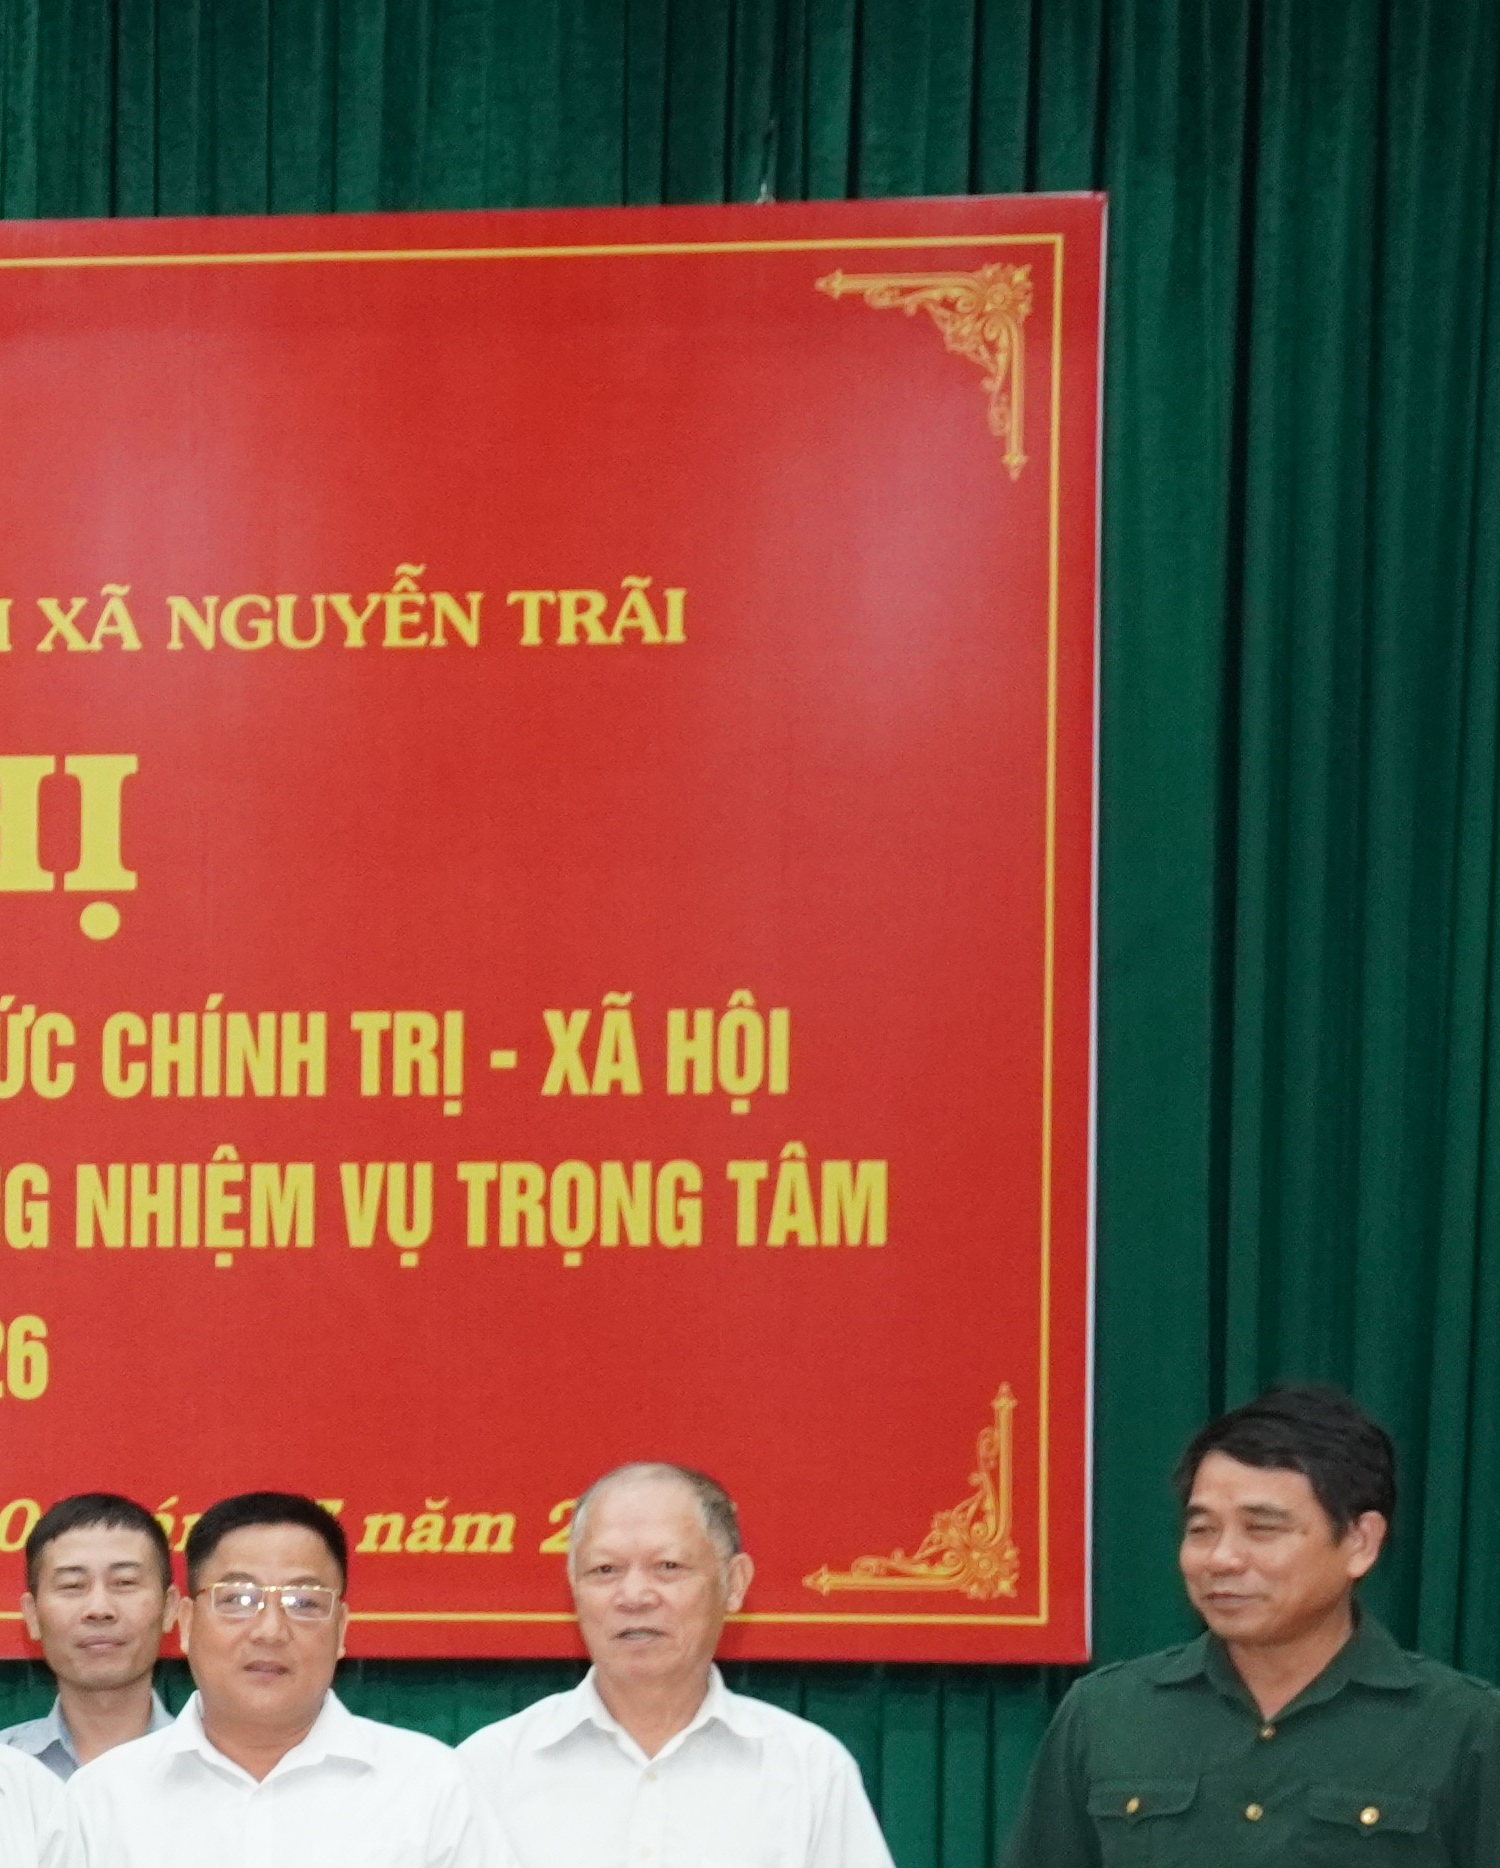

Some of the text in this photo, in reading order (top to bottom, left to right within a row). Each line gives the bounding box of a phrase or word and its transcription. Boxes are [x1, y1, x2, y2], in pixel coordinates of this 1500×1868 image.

[38, 584, 141, 651] XÃ
[167, 563, 481, 650] NGUYỄN
[508, 577, 684, 644] TRÃI
[103, 994, 325, 1098] CHÍNH
[351, 1012, 462, 1114] TRỊ
[491, 1051, 515, 1067] -
[543, 993, 640, 1094] XÃ
[668, 990, 788, 1113] HỘI
[77, 1145, 314, 1267] NHIỆM
[341, 1163, 432, 1266] VỤ
[458, 1161, 701, 1266] TRỌNG
[728, 1143, 886, 1247] TÂM
[355, 1496, 516, 1553] năm
